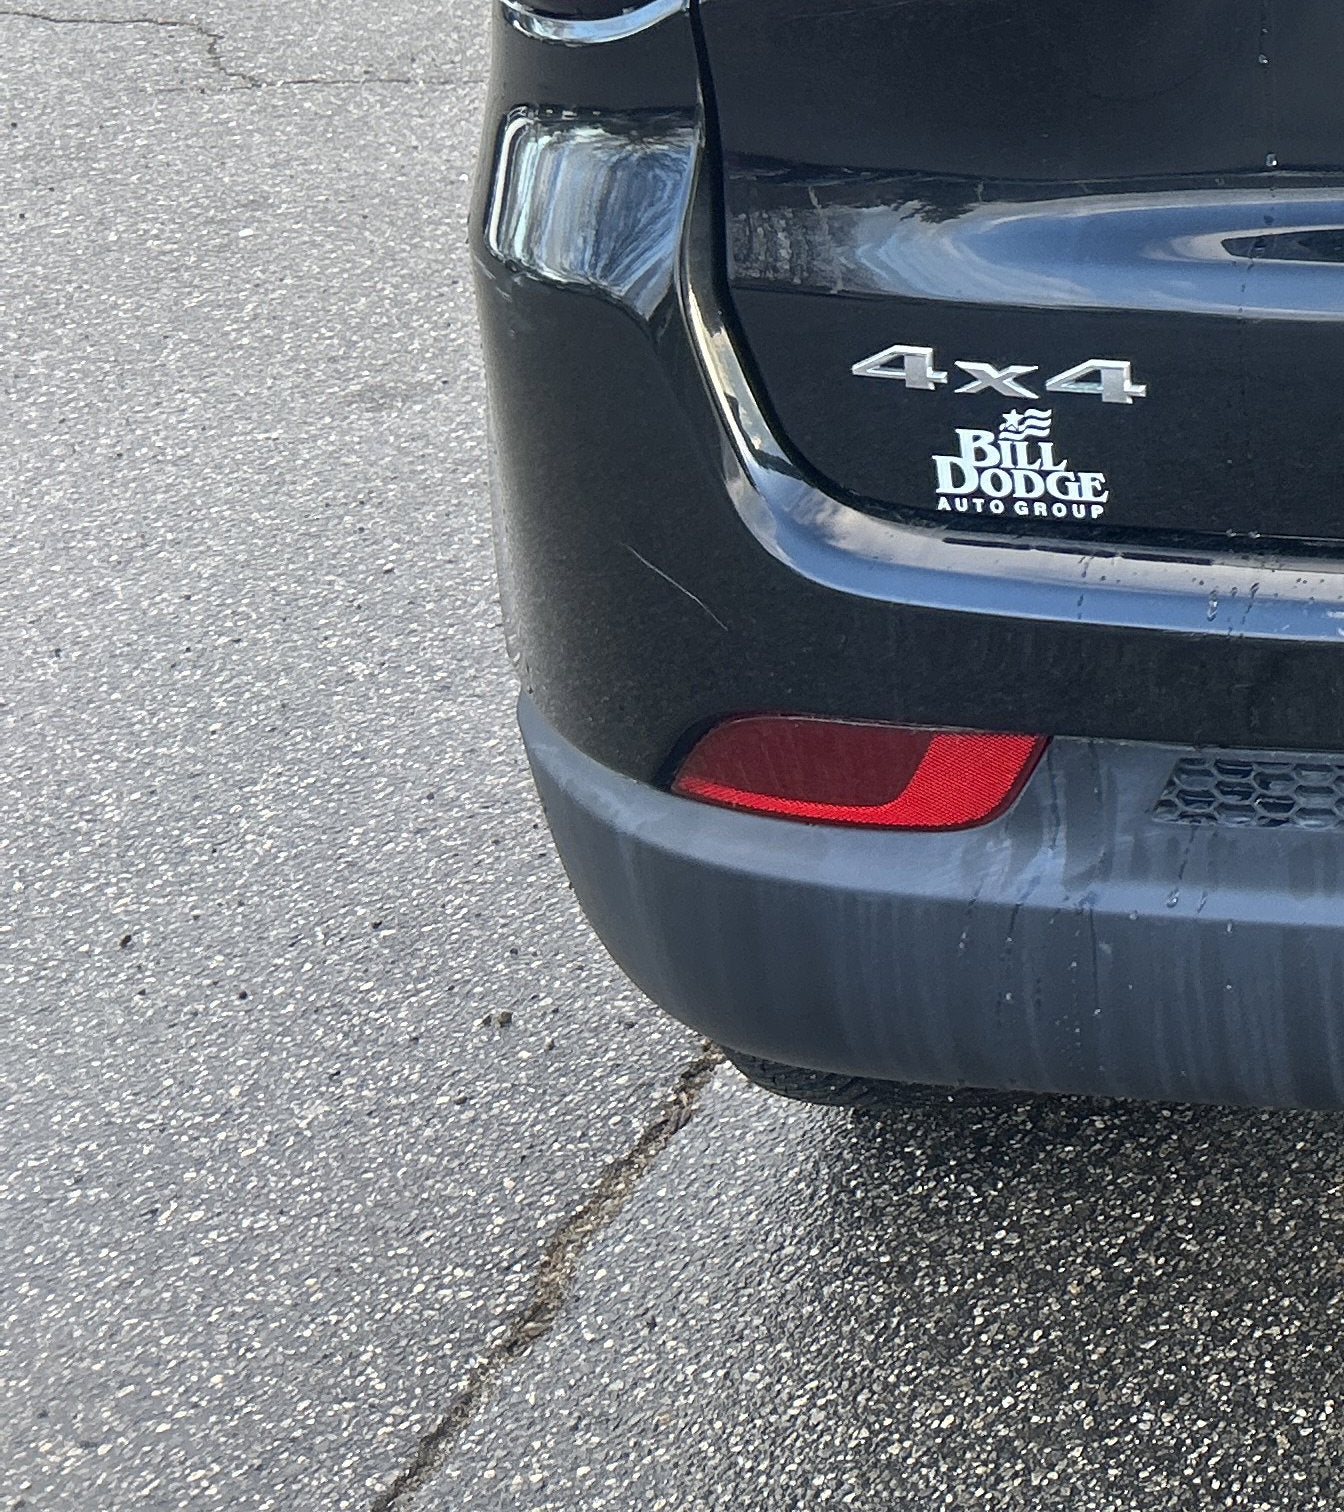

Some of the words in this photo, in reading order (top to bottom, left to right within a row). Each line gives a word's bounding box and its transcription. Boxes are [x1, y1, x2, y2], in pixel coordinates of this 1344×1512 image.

[851, 344, 1147, 404] 4x4
[954, 428, 1067, 472] BILL
[931, 454, 1109, 504] DODGE
[936, 496, 1005, 515] AUTO
[1013, 500, 1105, 520] GROUP
